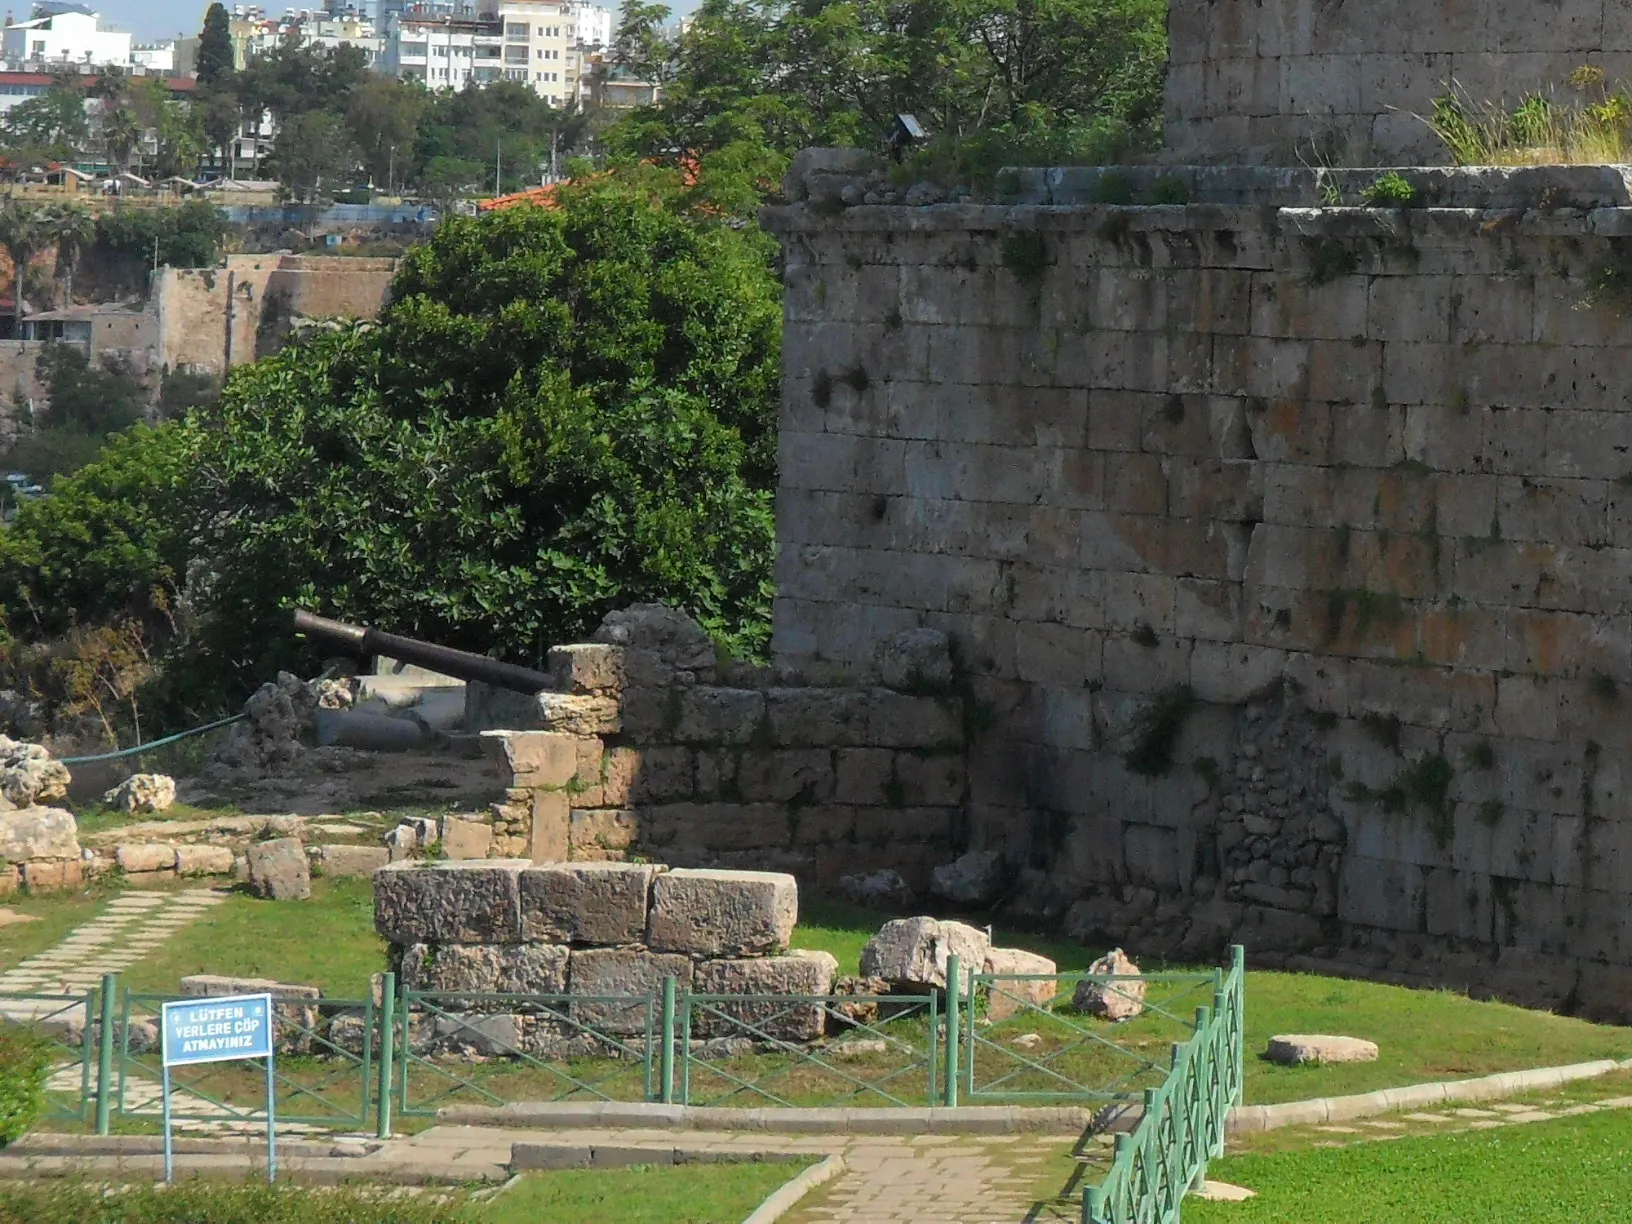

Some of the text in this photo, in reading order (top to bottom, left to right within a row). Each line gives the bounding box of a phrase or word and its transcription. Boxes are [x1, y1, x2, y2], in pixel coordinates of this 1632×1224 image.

[190, 1007, 244, 1023] LÜTFEN
[176, 1022, 232, 1038] YERLERE
[182, 1034, 253, 1053] ATMAYINIZ
